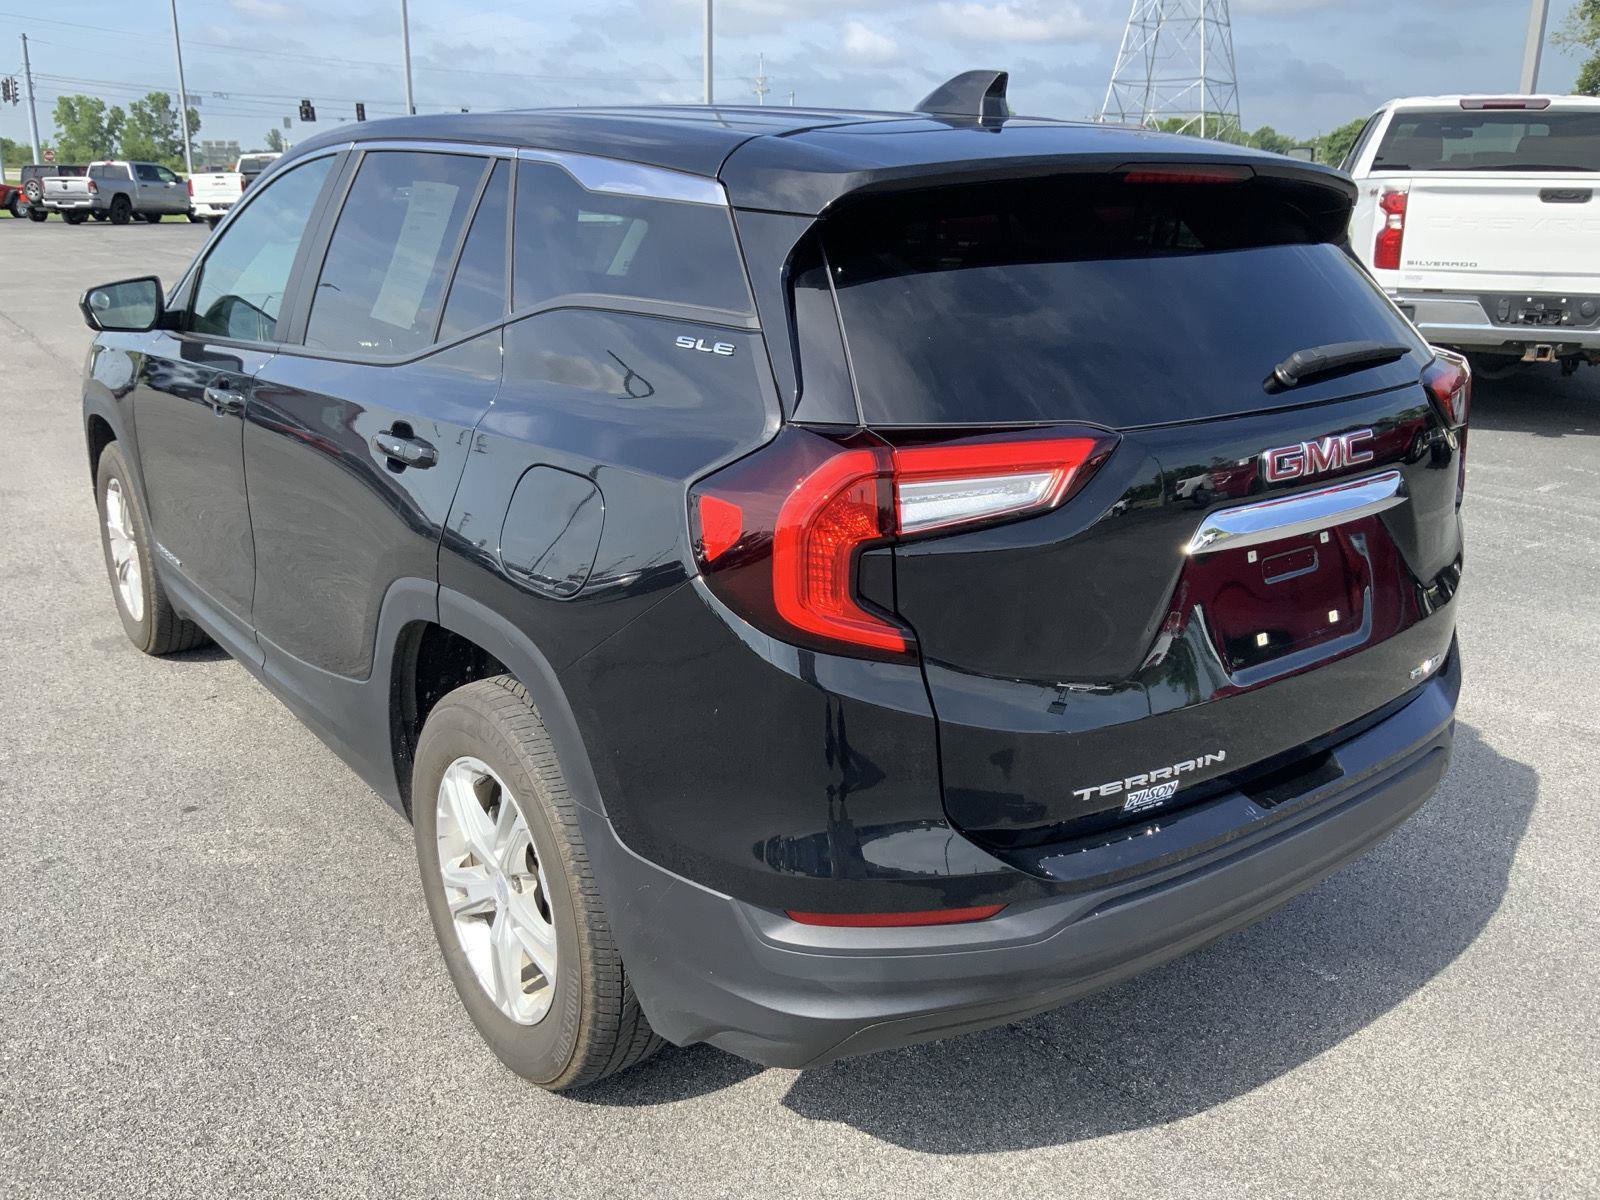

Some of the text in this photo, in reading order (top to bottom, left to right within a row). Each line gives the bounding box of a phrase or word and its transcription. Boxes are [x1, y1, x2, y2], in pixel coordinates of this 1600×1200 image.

[1406, 260, 1478, 268] SILVERADO
[675, 336, 735, 356] SLE
[1263, 428, 1374, 482] GMC
[1073, 750, 1226, 801] TERRAIN
[1126, 782, 1177, 807] PILSON
